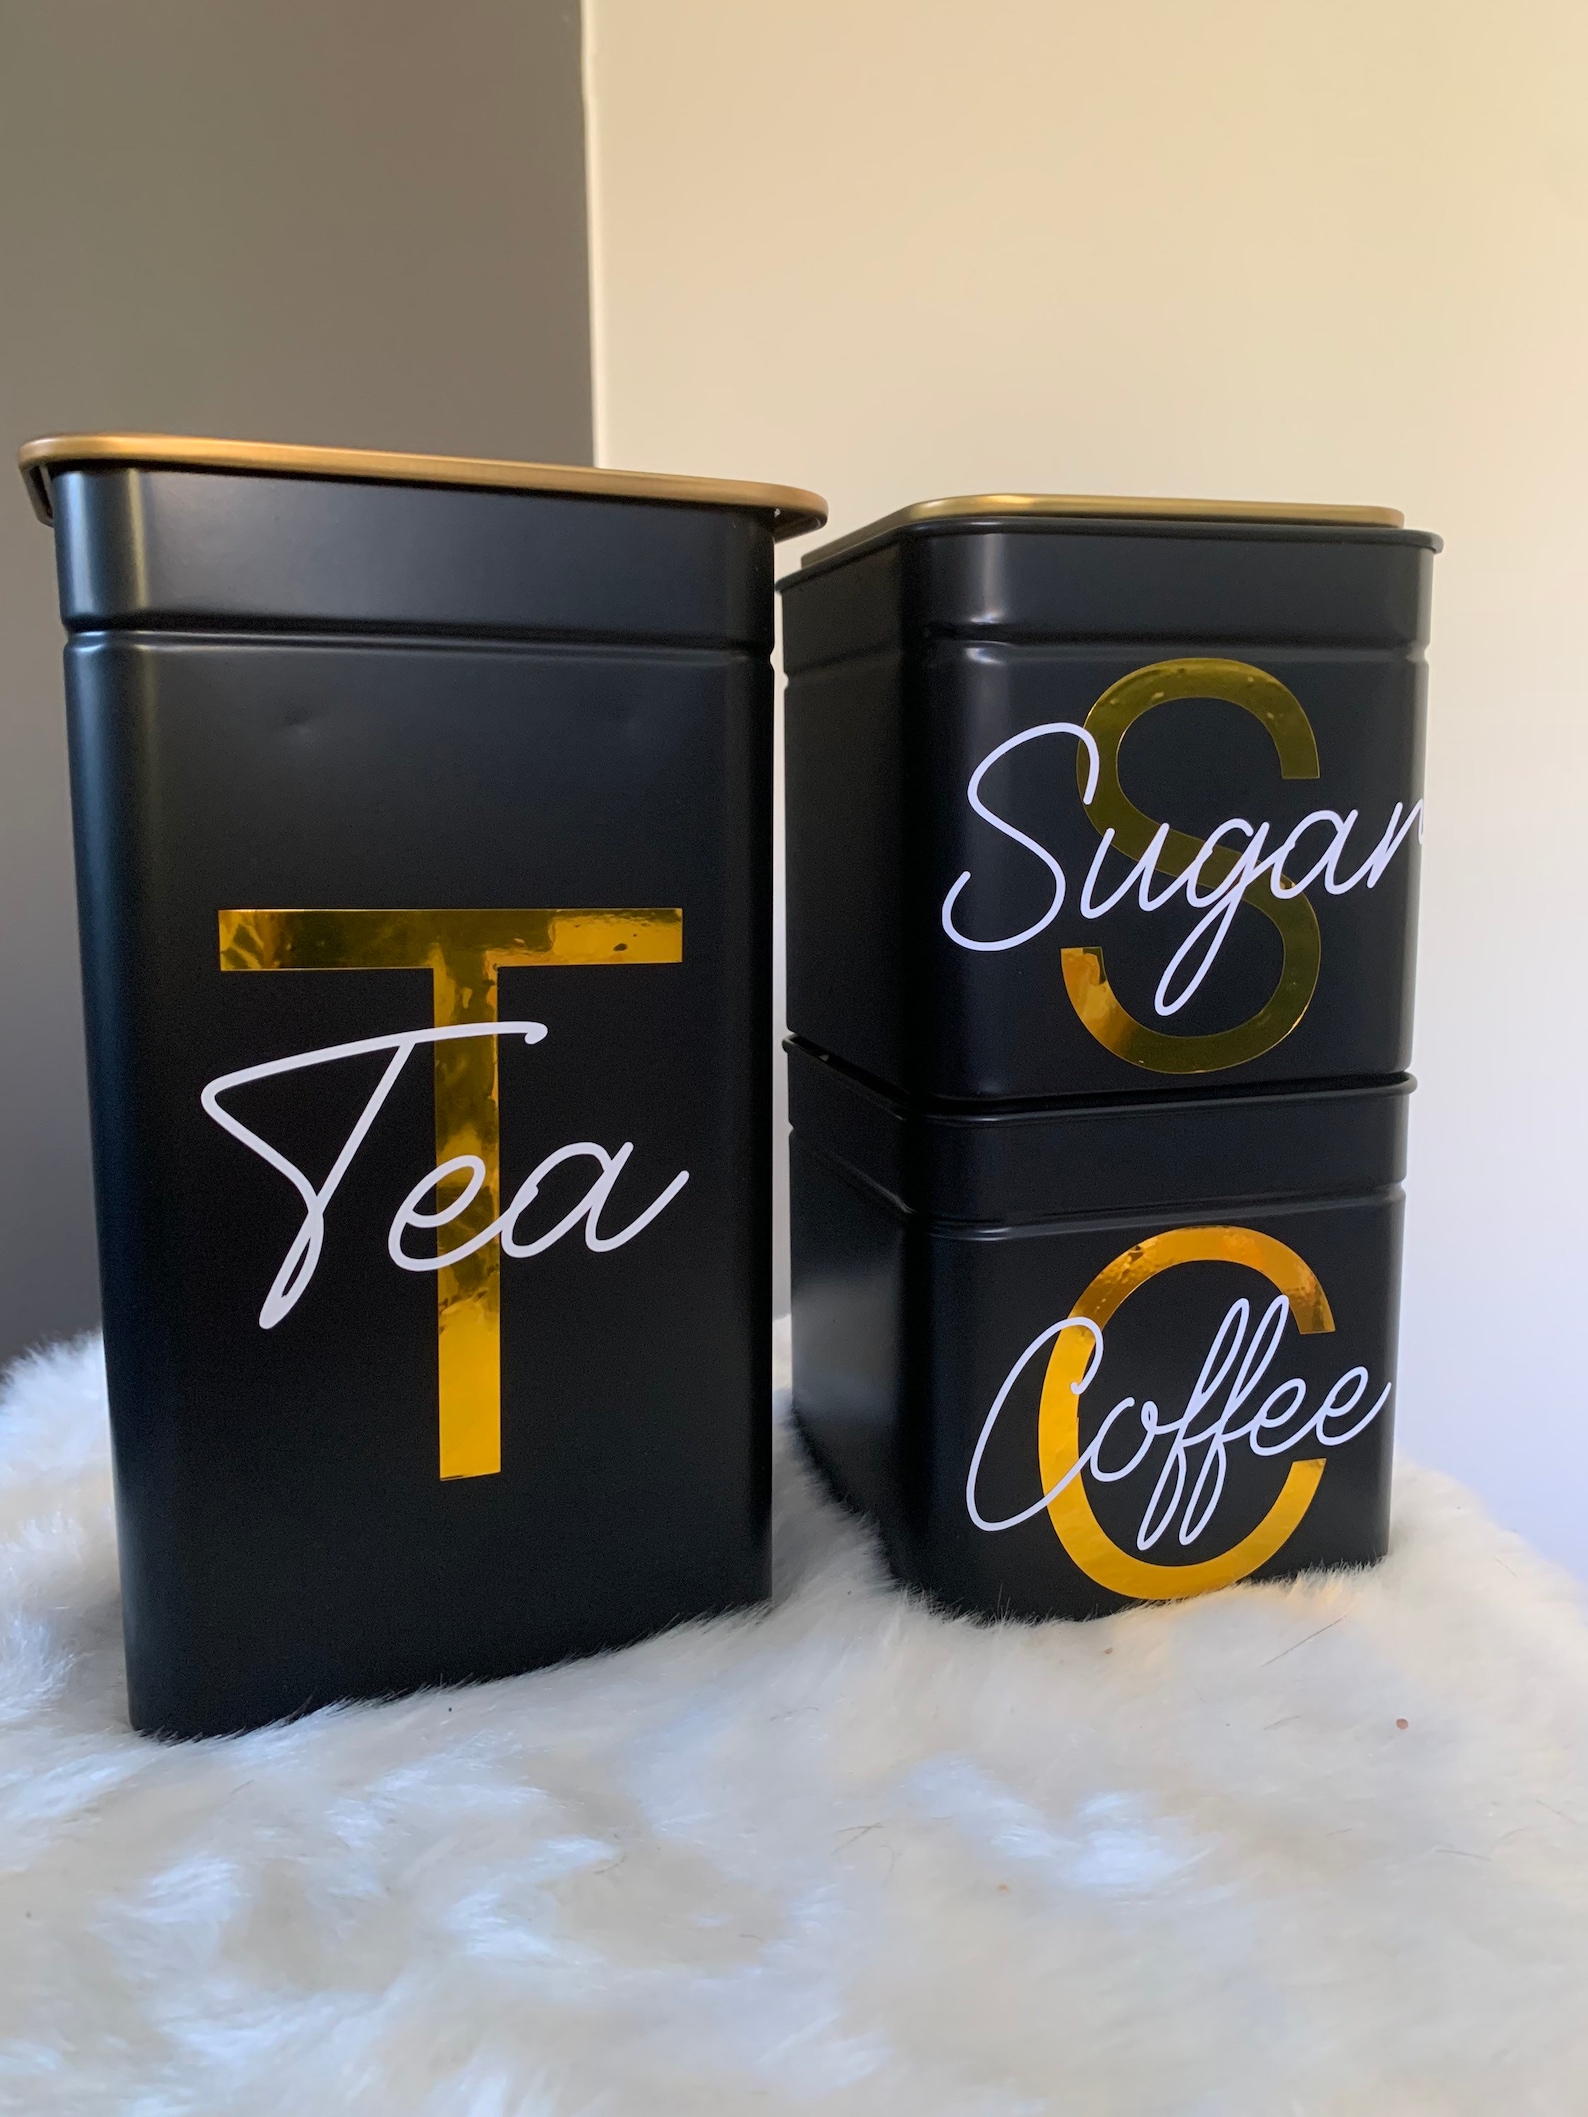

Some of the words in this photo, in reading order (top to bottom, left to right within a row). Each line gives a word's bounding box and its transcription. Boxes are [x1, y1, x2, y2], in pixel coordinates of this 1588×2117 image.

[1061, 658, 1321, 1074] S
[201, 1021, 690, 1330] Tea
[218, 908, 684, 1481] T
[966, 1295, 1392, 1551] Coffee
[1038, 1225, 1336, 1600] C
